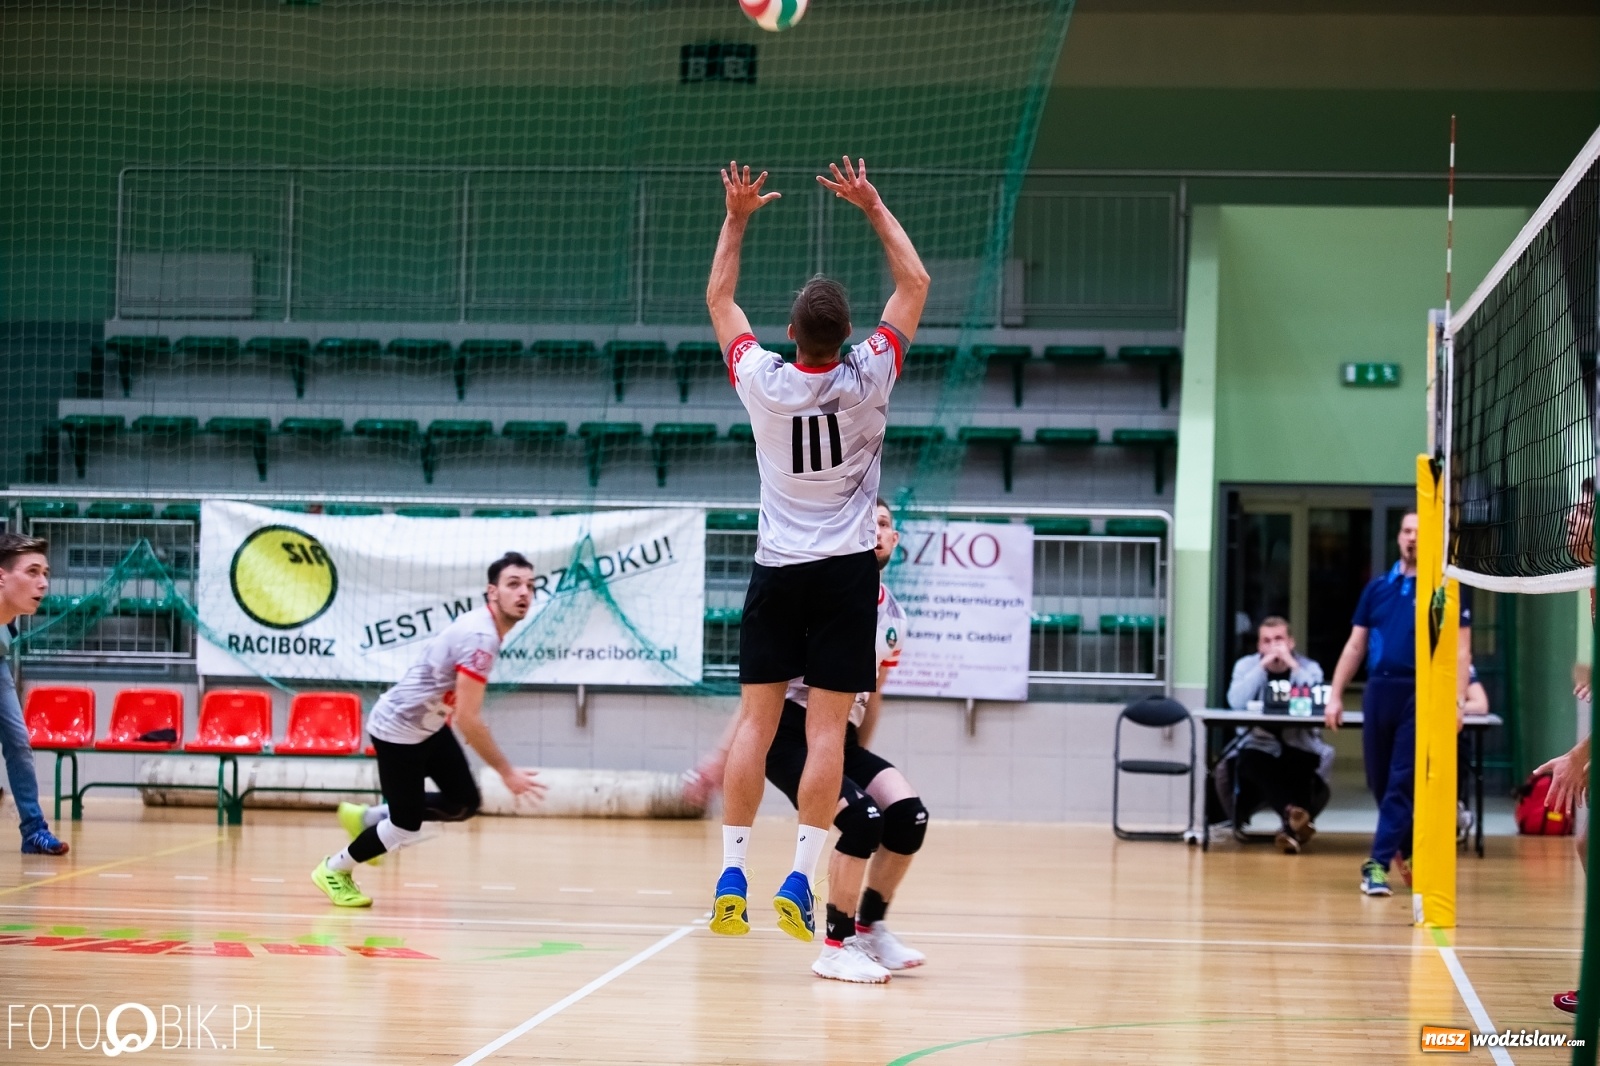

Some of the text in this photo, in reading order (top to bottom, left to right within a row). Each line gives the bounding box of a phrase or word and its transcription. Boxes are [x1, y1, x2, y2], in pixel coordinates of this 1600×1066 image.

[892, 531, 1001, 567] SZKO
[904, 606, 961, 621] dukcyjny
[360, 607, 433, 650] JEST
[906, 630, 1013, 643] kamy na Ciebie!
[228, 631, 336, 657] RACIBÓRZ
[499, 645, 678, 662] ww.osir-raciborz.pl
